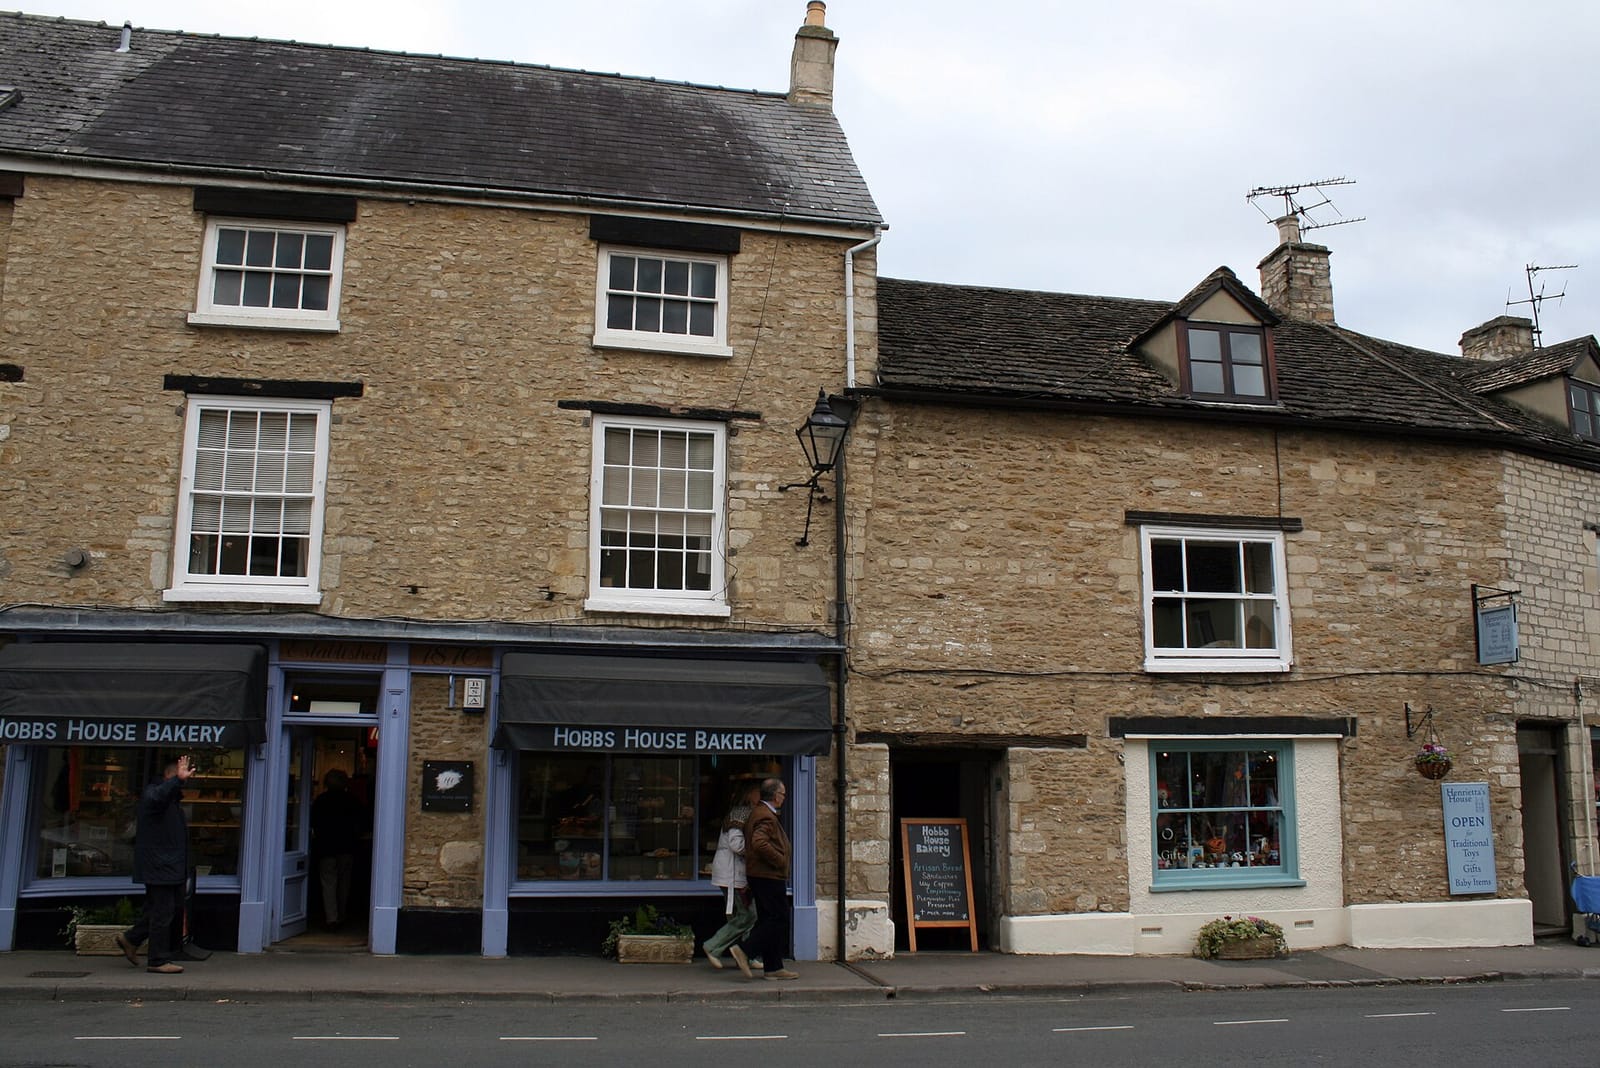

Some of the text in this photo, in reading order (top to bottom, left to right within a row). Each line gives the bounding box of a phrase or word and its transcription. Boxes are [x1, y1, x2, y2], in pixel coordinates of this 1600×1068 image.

[0, 718, 225, 743] OBBS HOUSE BAKERY
[554, 727, 766, 750] HOBBS HOUSE BAKERY
[1447, 788, 1486, 797] Henrietta's
[1452, 817, 1485, 827] OPEN
[922, 825, 950, 837] Hobbs
[923, 836, 950, 845] House
[1451, 838, 1489, 848] Traditional
[916, 844, 950, 857] Bakery
[1161, 848, 1186, 861] Gifts
[1462, 848, 1480, 860] Toys
[913, 862, 940, 872] Artisan
[1463, 863, 1482, 873] Gifts
[1455, 877, 1491, 889] Baby Items
